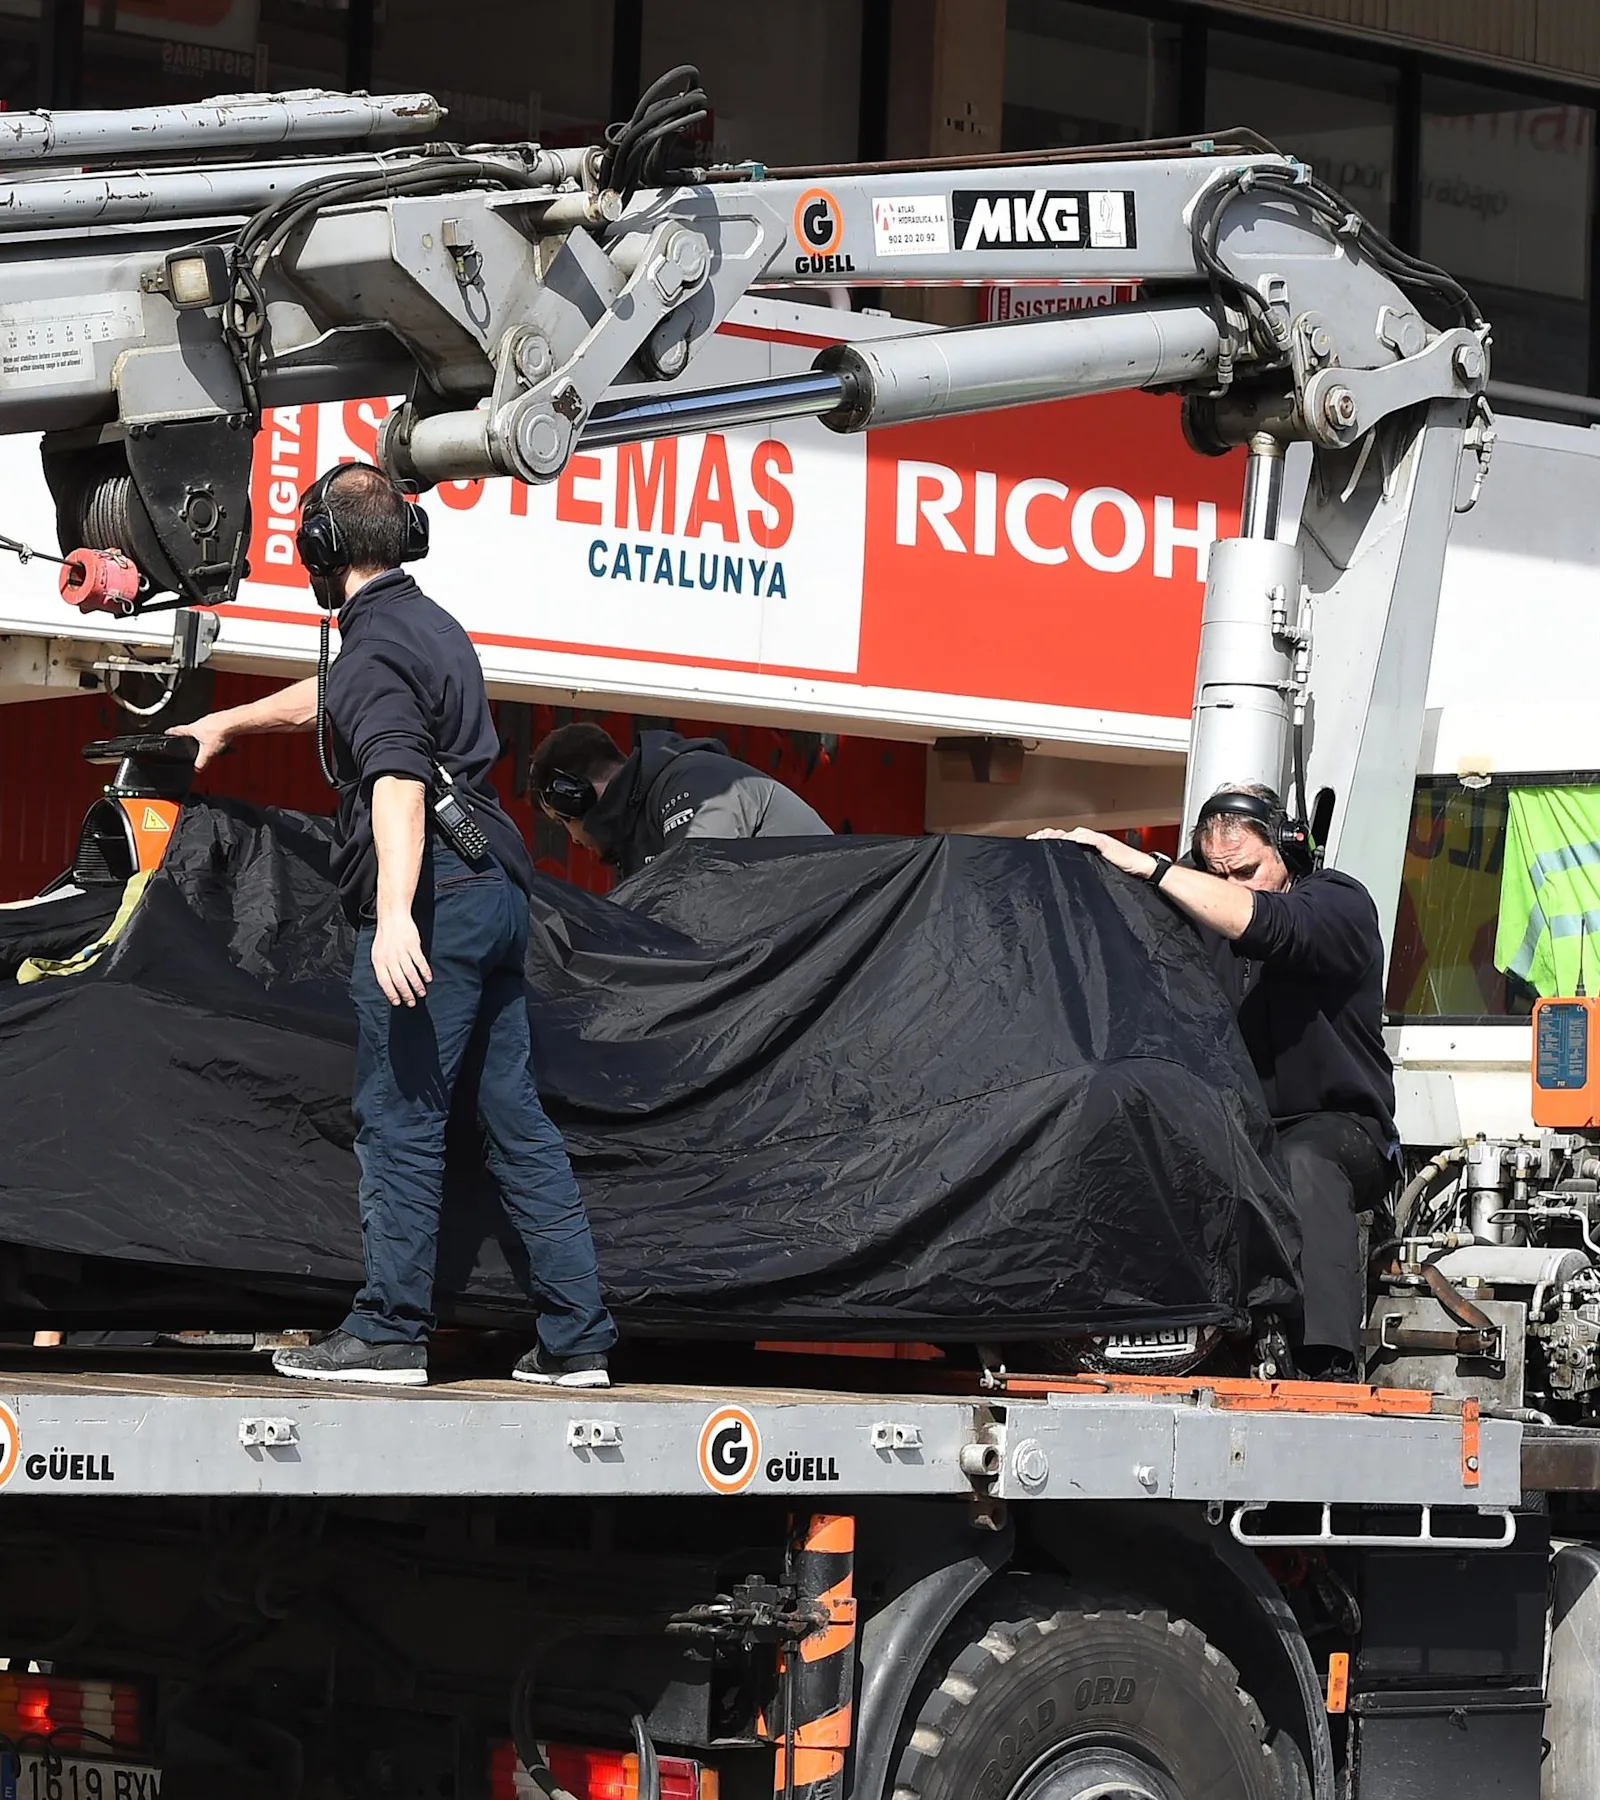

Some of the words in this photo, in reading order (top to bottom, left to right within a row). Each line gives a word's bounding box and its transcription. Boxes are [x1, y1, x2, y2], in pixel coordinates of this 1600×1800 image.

[898, 205, 915, 214] ATLAS
[961, 189, 1080, 251] MKG
[888, 234, 903, 244] 902
[904, 233, 914, 243] 20
[916, 233, 925, 243] 20
[926, 232, 936, 242] 92
[795, 253, 856, 275] GÜELL
[895, 459, 1217, 584] RICOH
[588, 539, 788, 600] CATALUNYA
[25, 1446, 115, 1481] GÜELL
[765, 1451, 840, 1482] GÜELL
